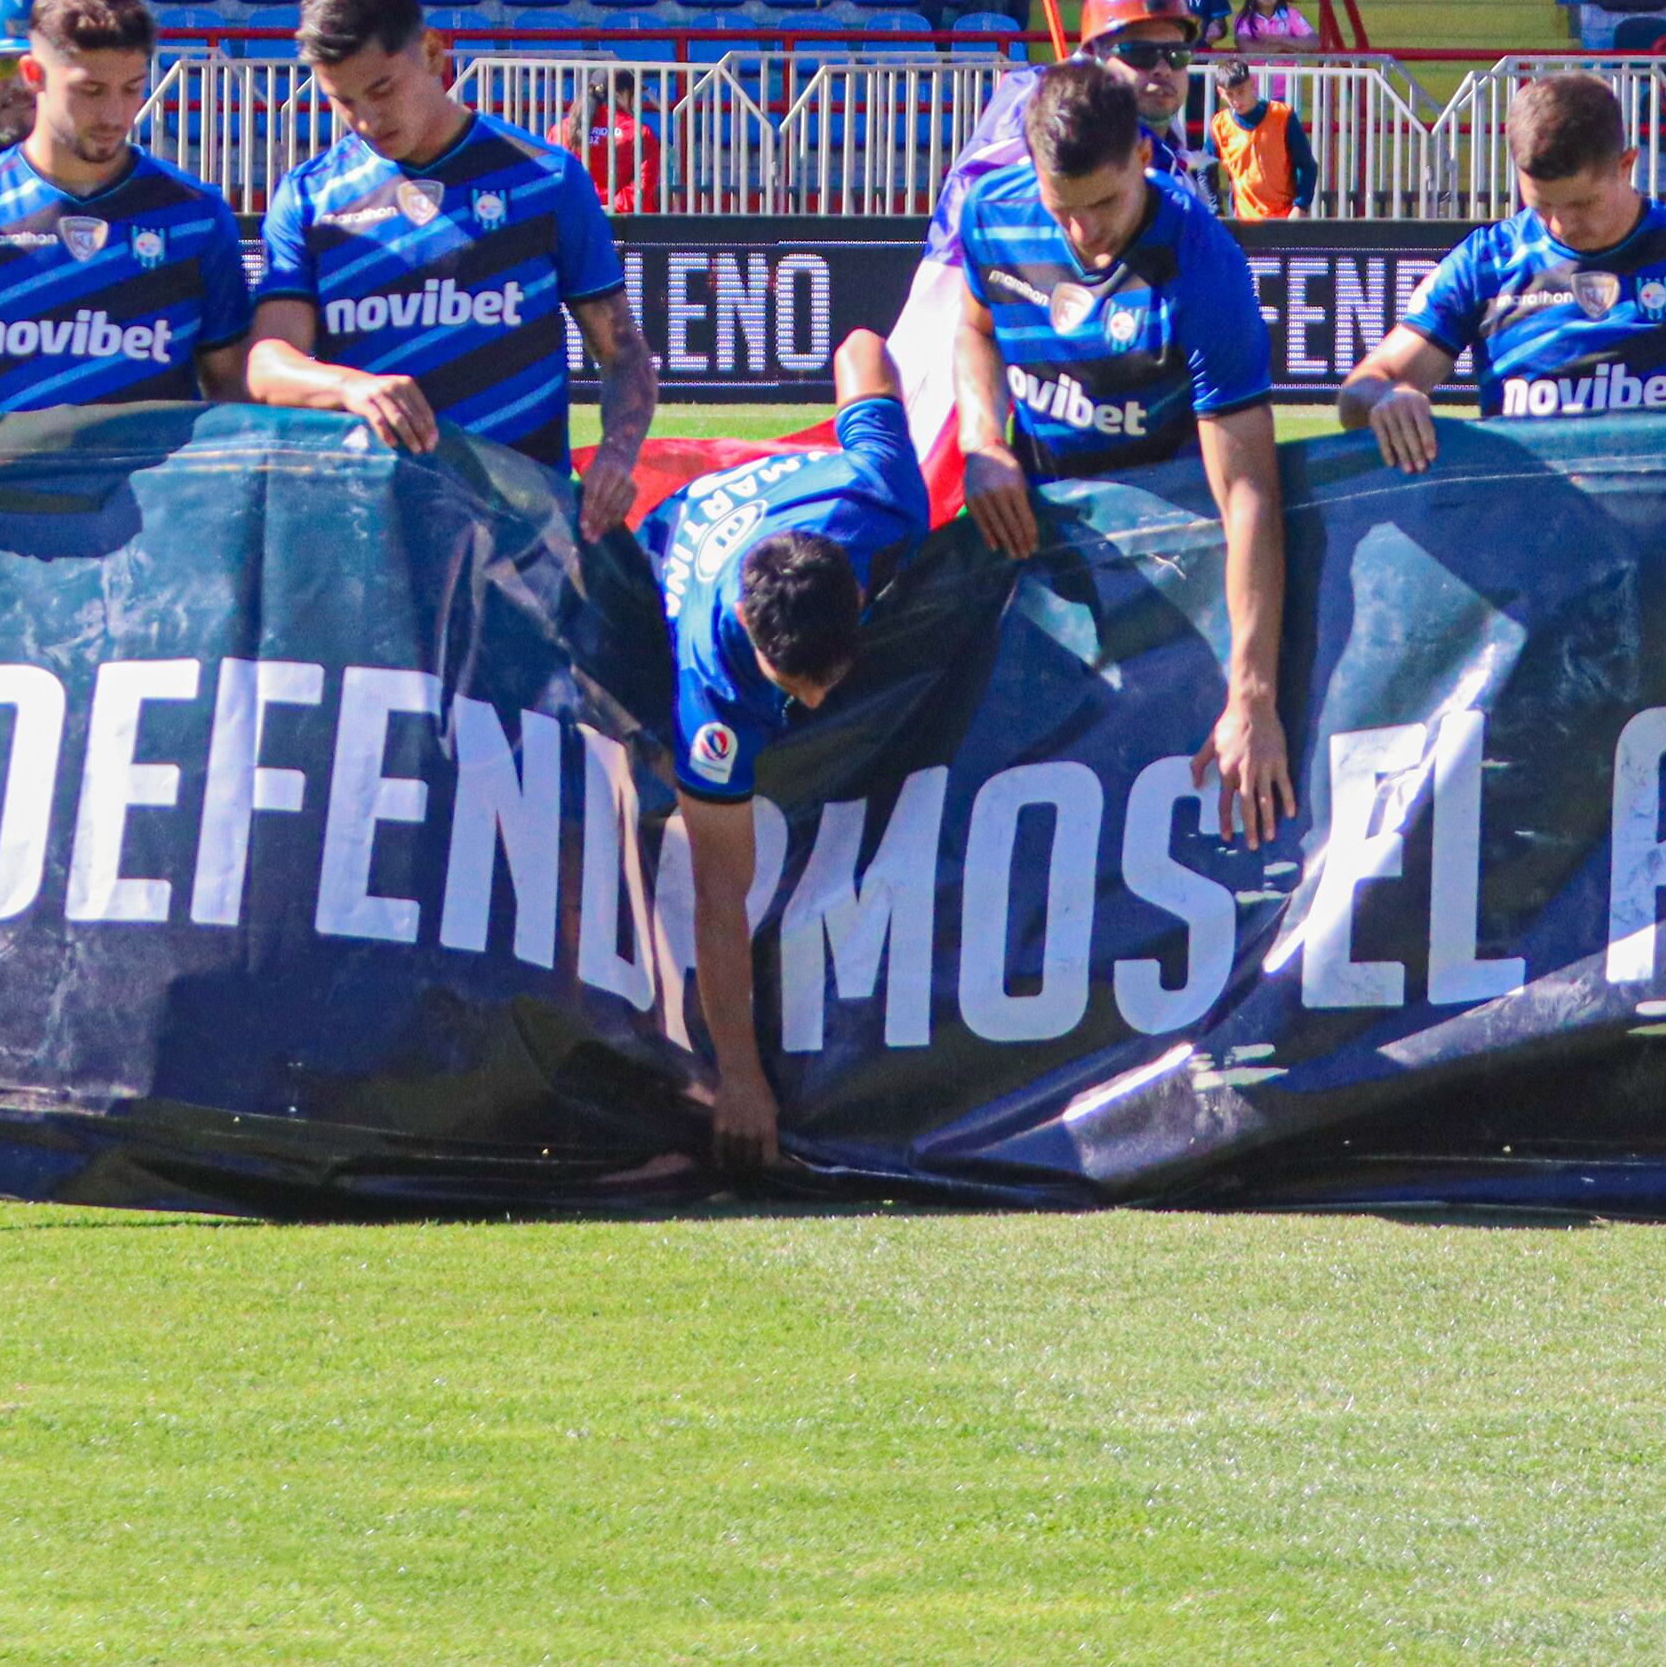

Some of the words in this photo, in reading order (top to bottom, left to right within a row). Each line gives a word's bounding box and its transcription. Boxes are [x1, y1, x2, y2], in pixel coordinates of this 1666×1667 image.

[321, 206, 399, 224] marathon
[324, 278, 524, 335] novibet
[988, 269, 1050, 307] marathon
[1495, 291, 1575, 309] marathon
[1007, 364, 1147, 437] ovibet
[1293, 709, 1526, 1007] EL
